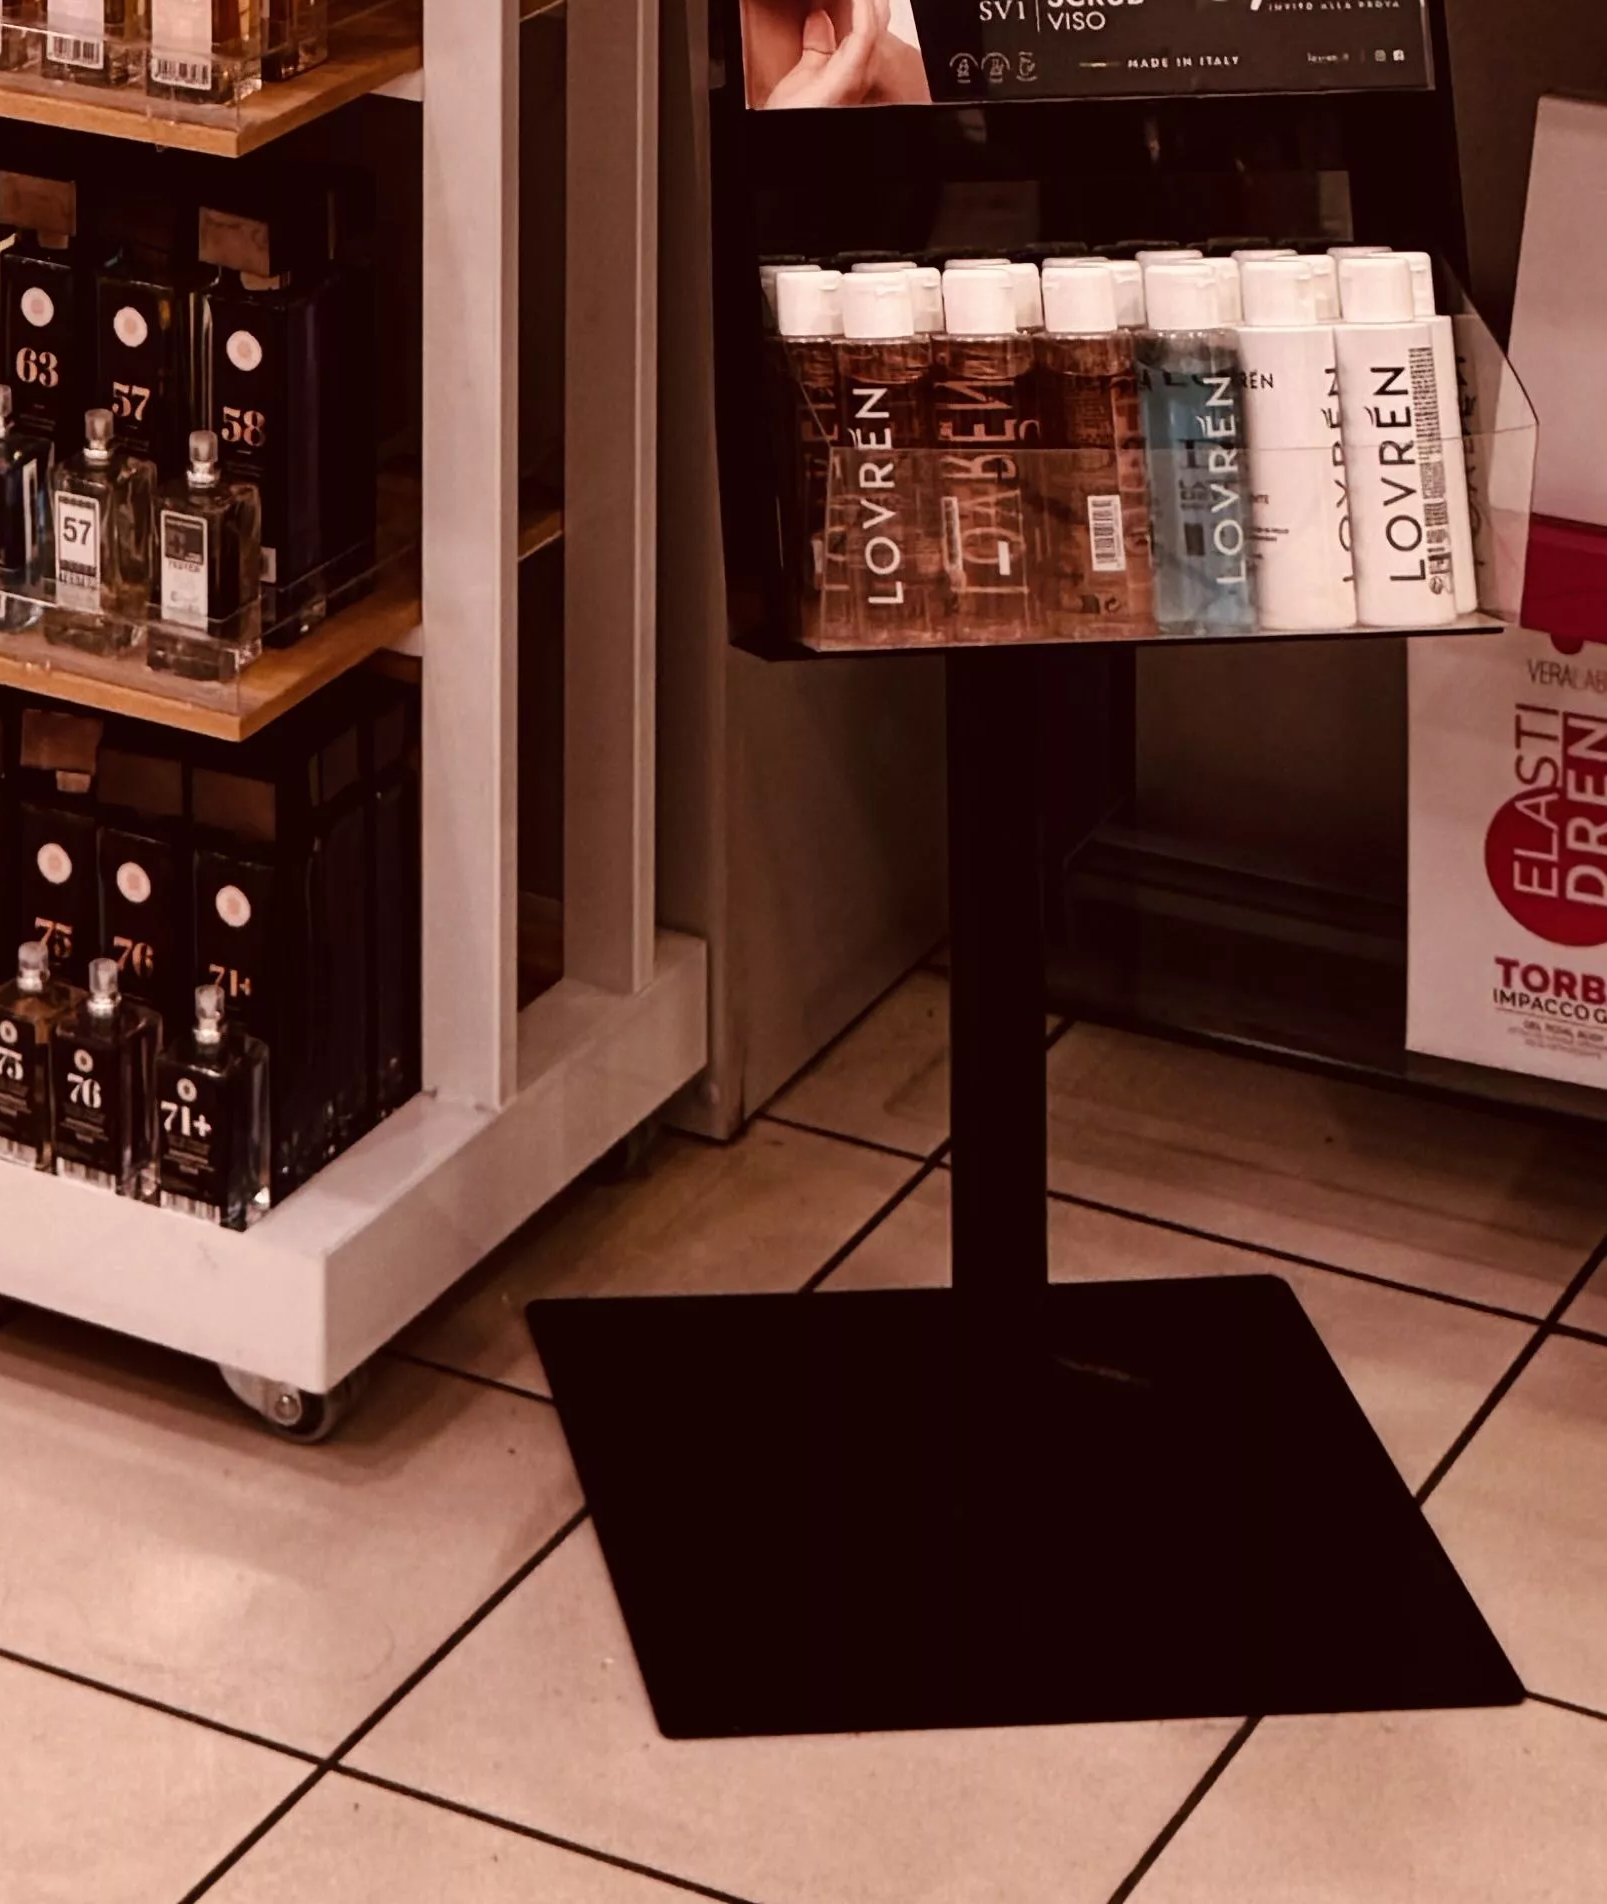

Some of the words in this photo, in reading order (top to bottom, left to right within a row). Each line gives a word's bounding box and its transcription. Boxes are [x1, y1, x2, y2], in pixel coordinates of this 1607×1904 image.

[1048, 9, 1106, 32] VISO
[1127, 58, 1171, 70] MADE
[1176, 57, 1194, 68] IN
[1198, 54, 1239, 67] ITALY
[15, 347, 59, 388] 63
[112, 381, 151, 421] 57
[221, 407, 266, 447] 58
[1196, 375, 1247, 586] LOVRÉN
[1370, 364, 1429, 584] LOVRÉN
[852, 387, 905, 606] LOVRÉN
[63, 517, 92, 545] 57
[1493, 988, 1588, 1024] IMPACCO
[160, 1102, 212, 1138] 71+
